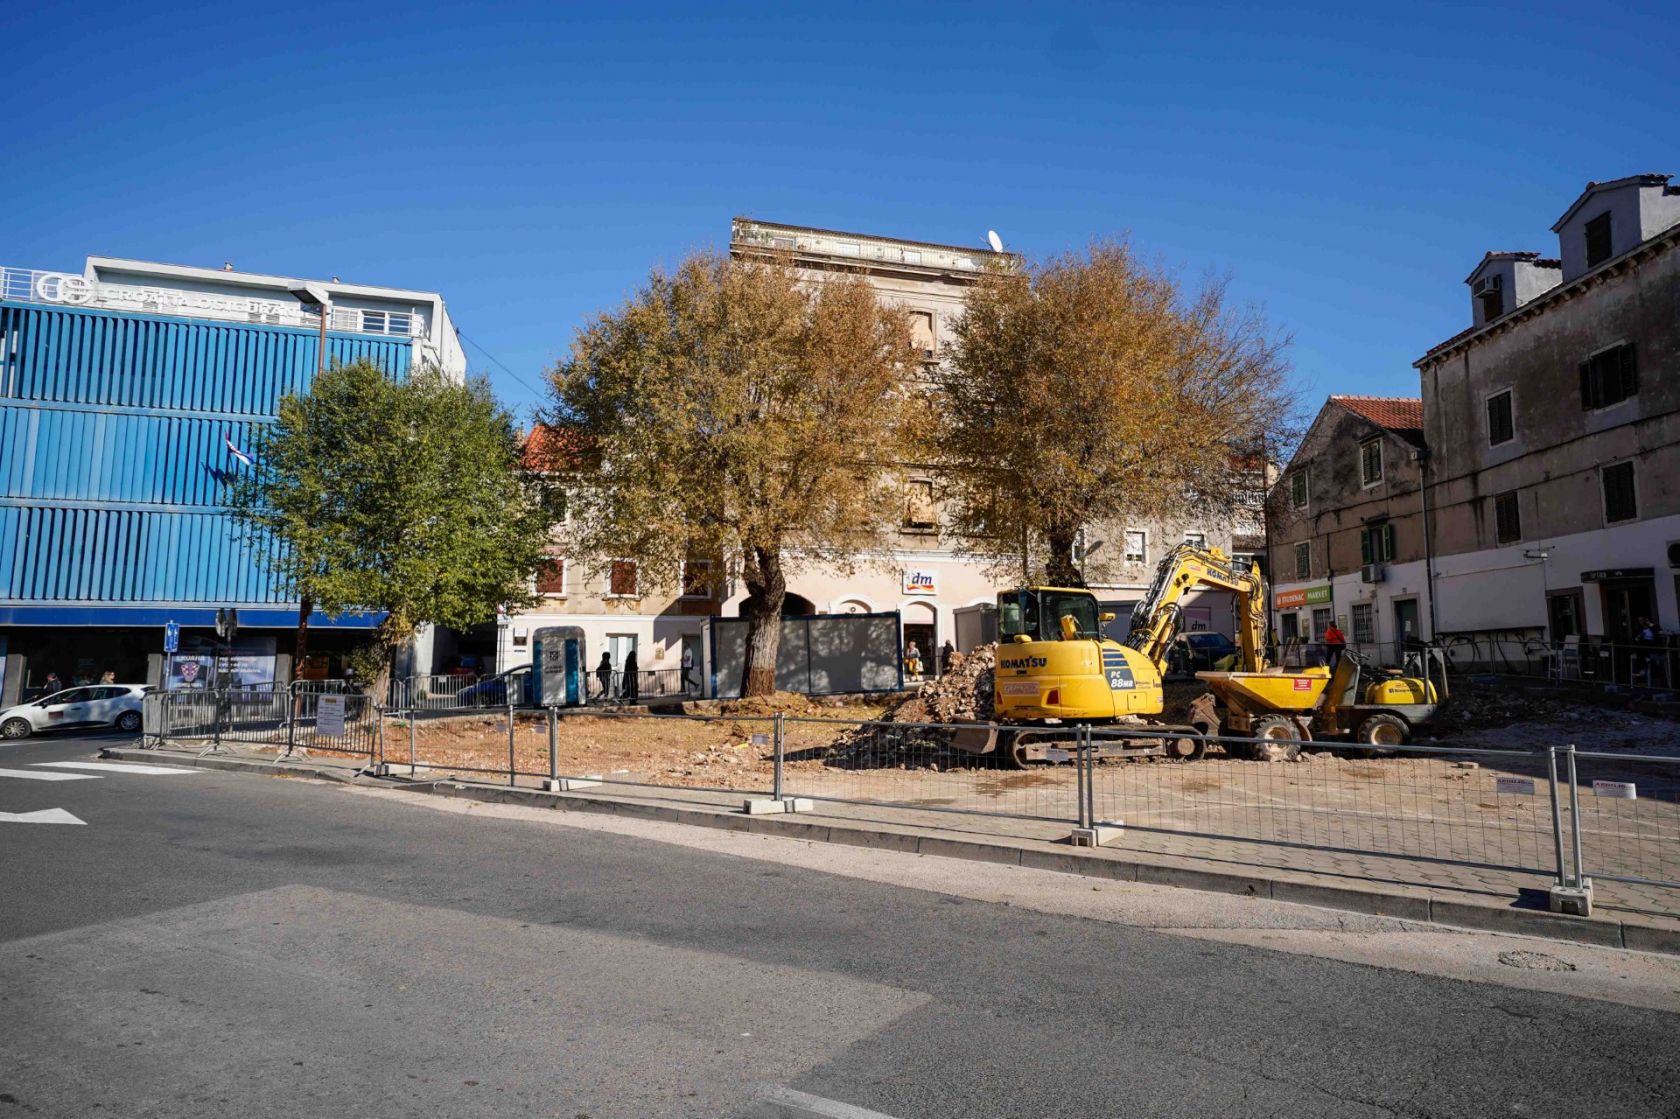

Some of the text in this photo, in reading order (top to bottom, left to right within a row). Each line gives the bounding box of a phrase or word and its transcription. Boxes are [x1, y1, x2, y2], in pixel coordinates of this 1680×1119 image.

[911, 572, 932, 585] dm
[1206, 568, 1239, 586] KOMATSU
[1307, 590, 1328, 600] MARKET
[1191, 620, 1206, 631] dm
[1001, 656, 1047, 669] KOMATSU
[1110, 671, 1121, 679] PC
